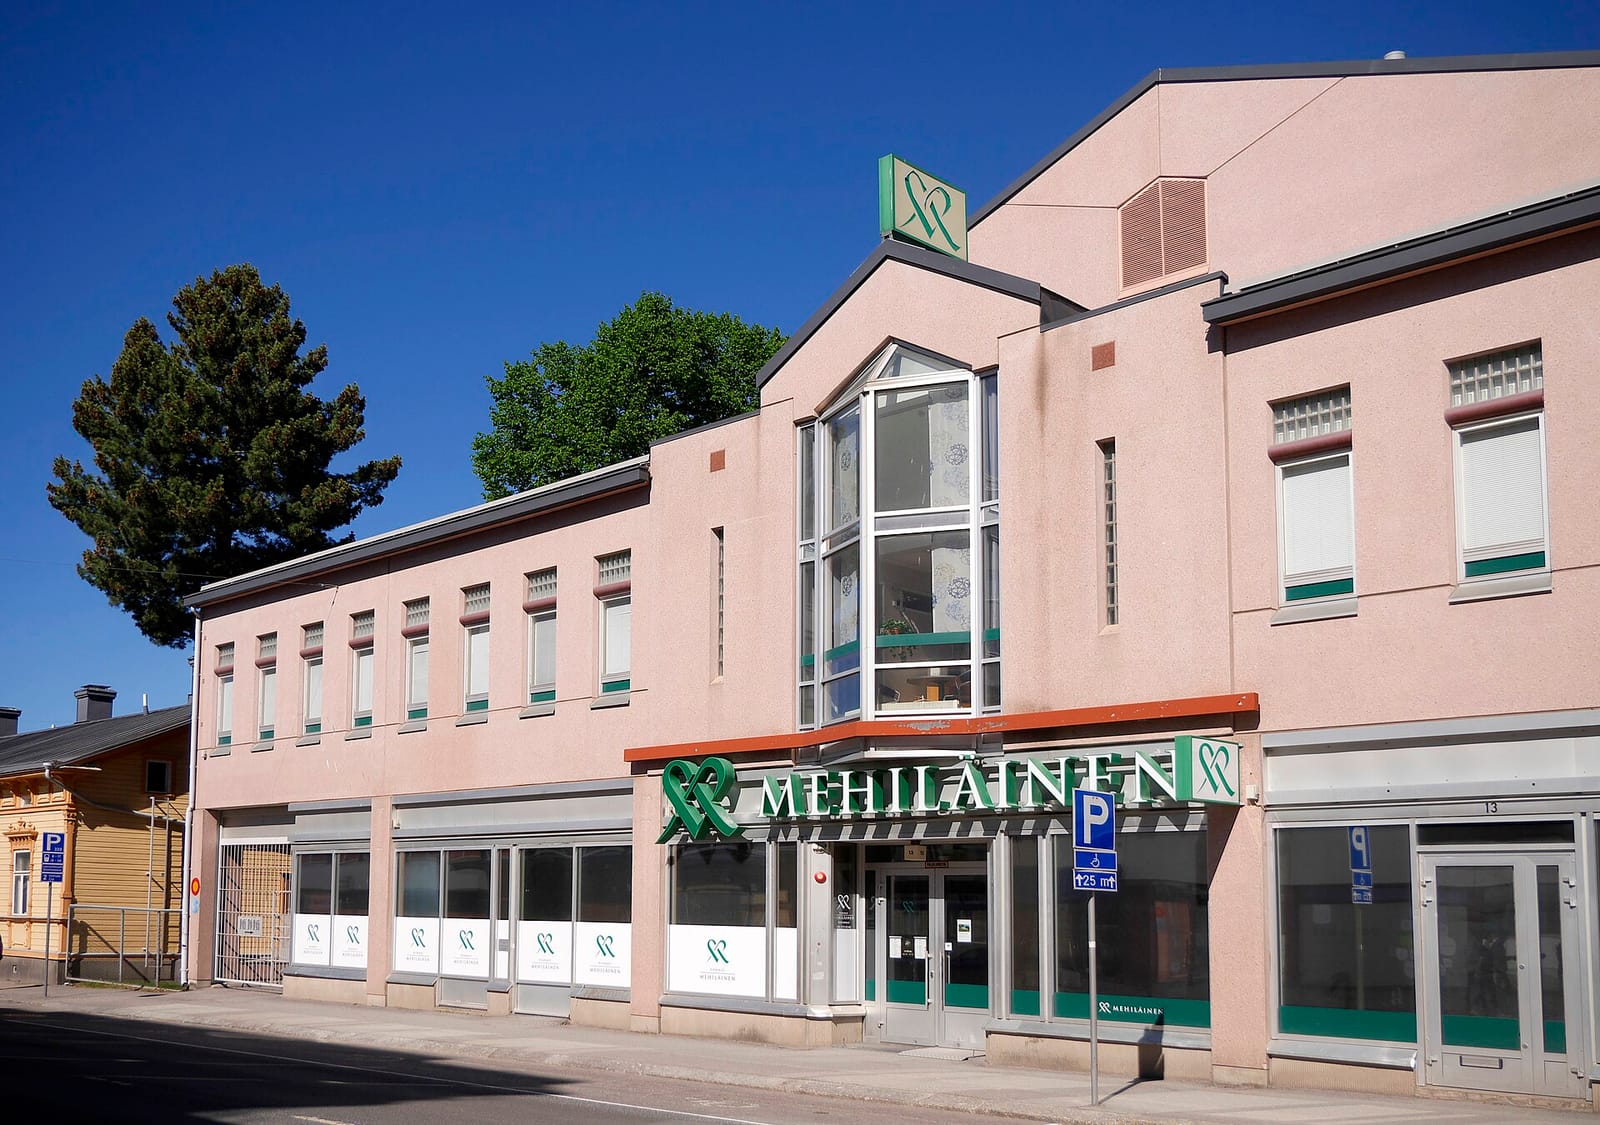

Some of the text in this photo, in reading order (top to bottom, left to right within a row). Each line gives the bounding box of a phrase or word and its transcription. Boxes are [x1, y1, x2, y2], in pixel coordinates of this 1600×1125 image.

[757, 750, 1177, 817] MEHILÄINEN
[1485, 801, 1498, 814] 13
[1083, 795, 1109, 844] P
[46, 833, 62, 851] P
[1083, 875, 1109, 887] 25 m
[1112, 1004, 1165, 1016] MEHILÄINEN
